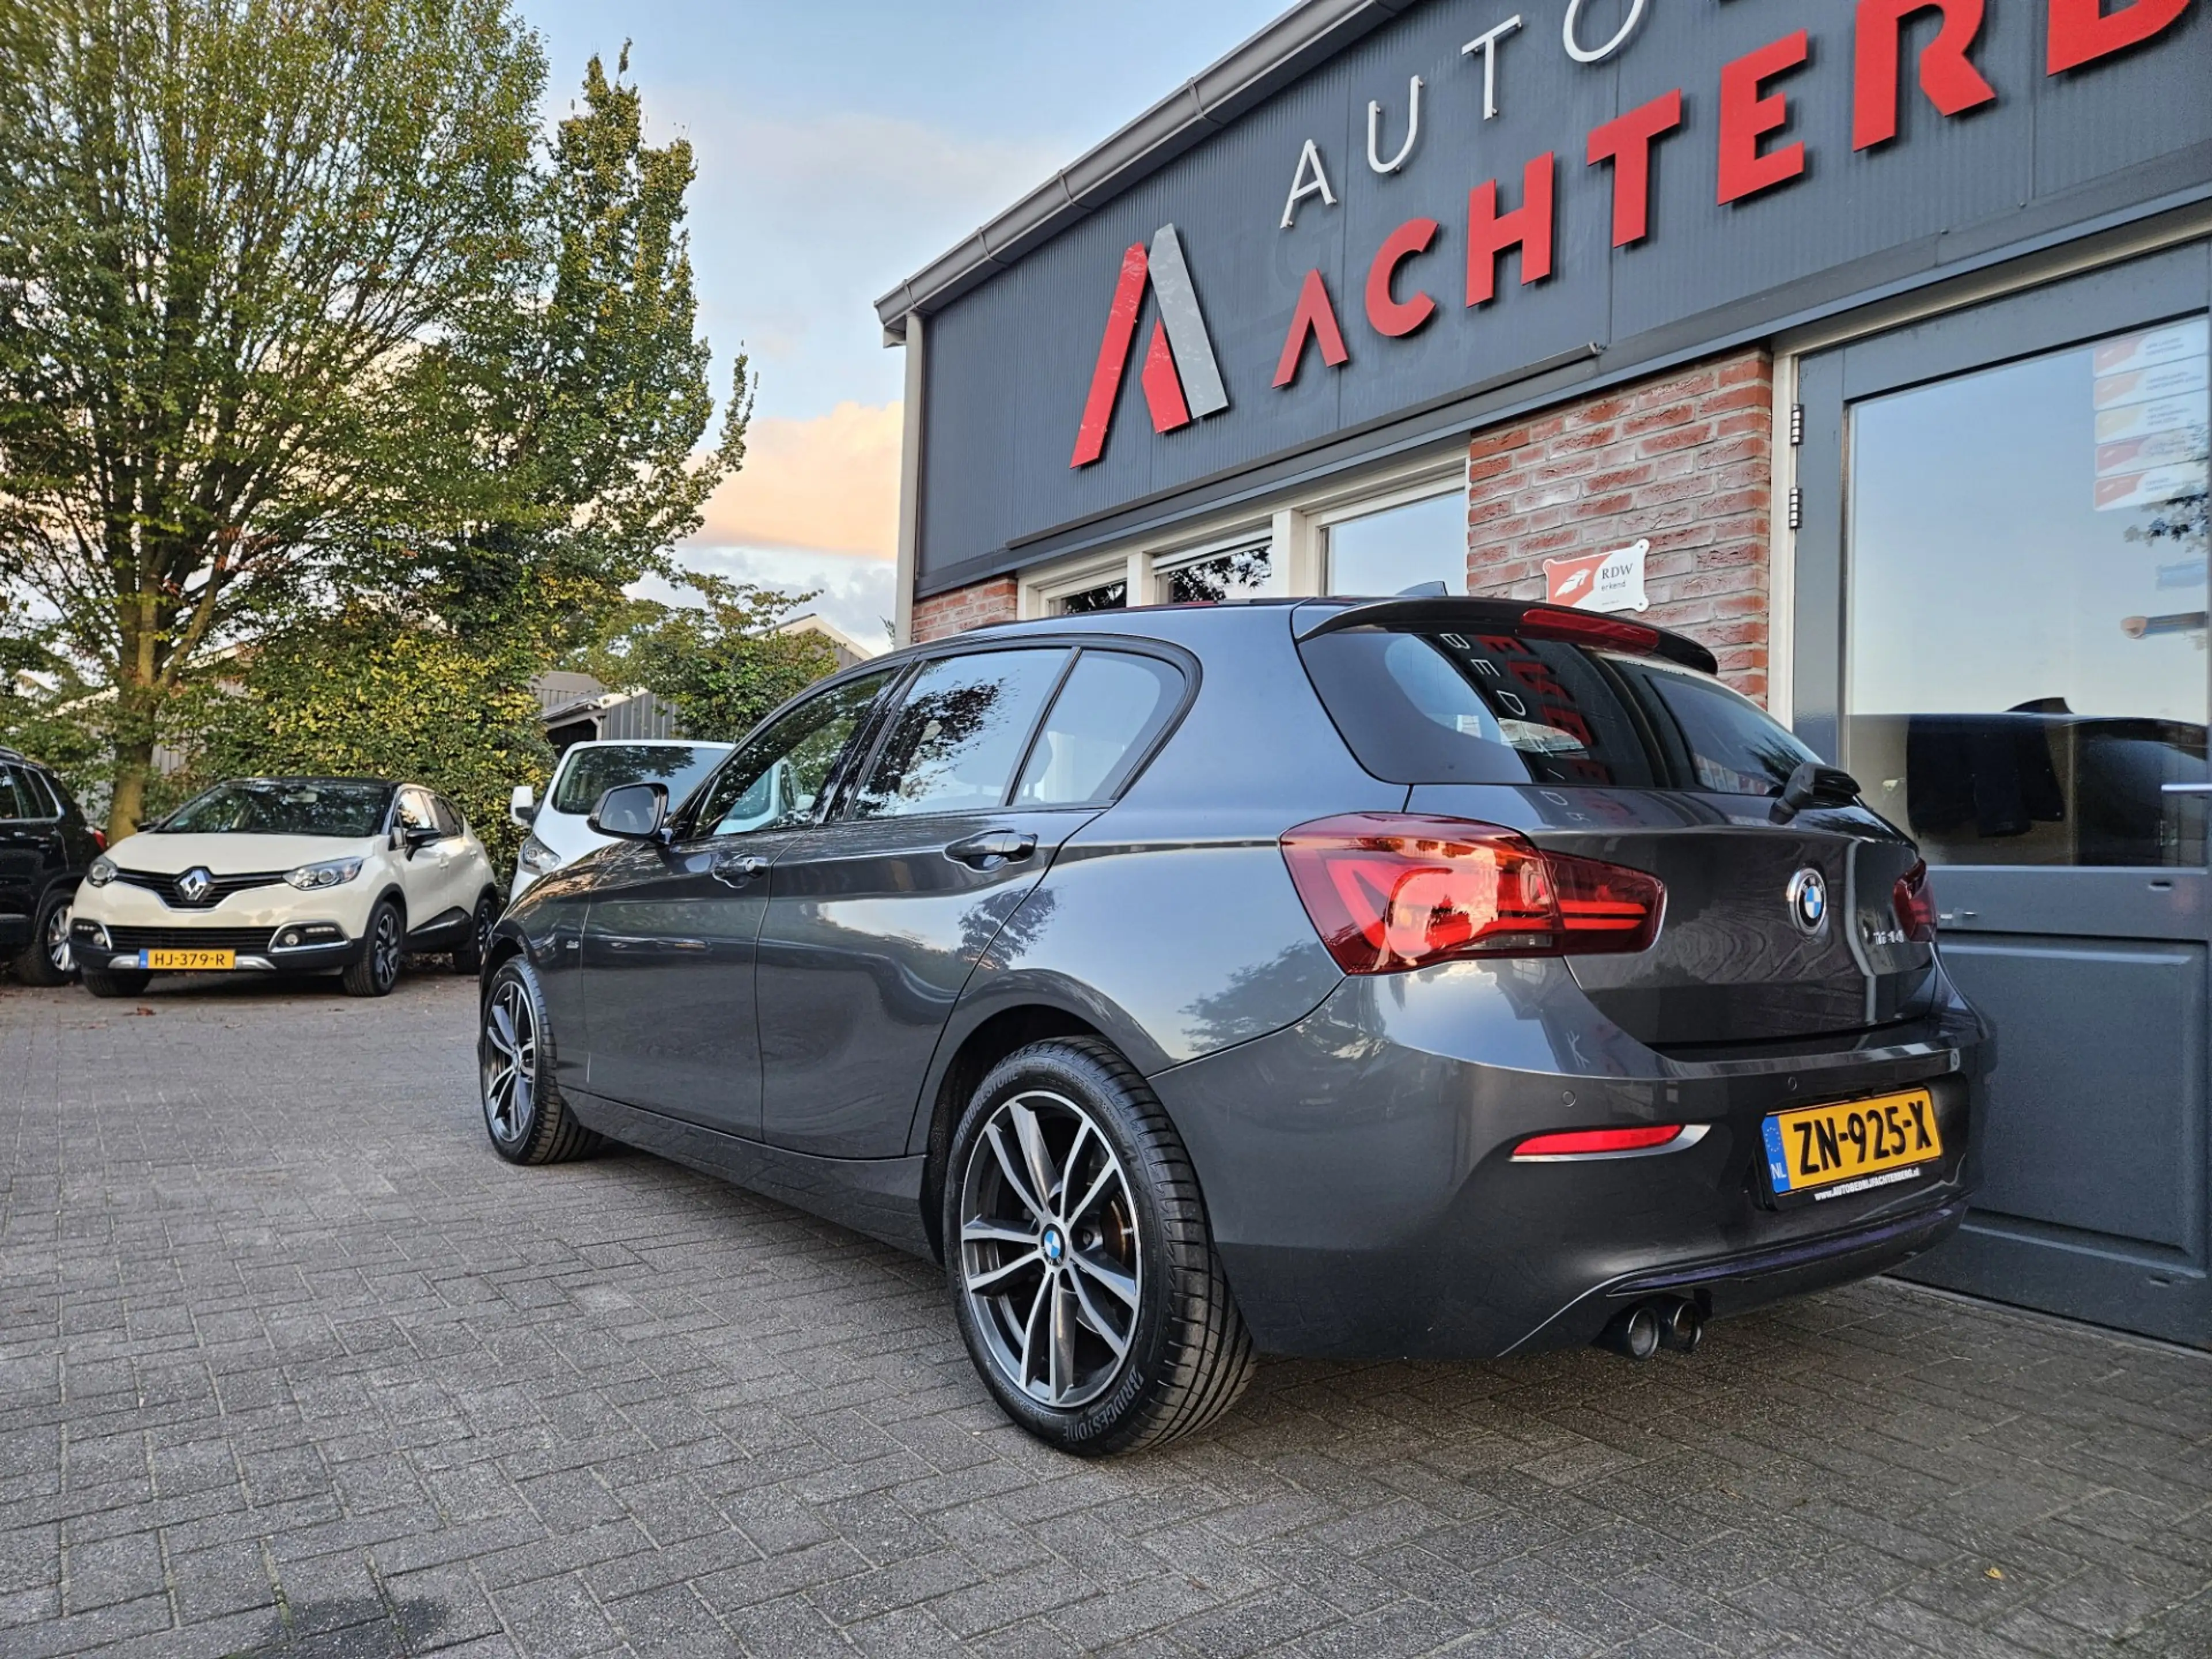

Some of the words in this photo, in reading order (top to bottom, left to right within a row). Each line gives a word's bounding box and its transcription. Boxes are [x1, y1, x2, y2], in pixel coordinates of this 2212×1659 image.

[1601, 563, 1634, 579] RDW
[1601, 580, 1626, 592] erkend
[154, 953, 225, 966] HJ-379-R
[1792, 1100, 1932, 1176] ZN-925-X
[1770, 1162, 1787, 1179] NL
